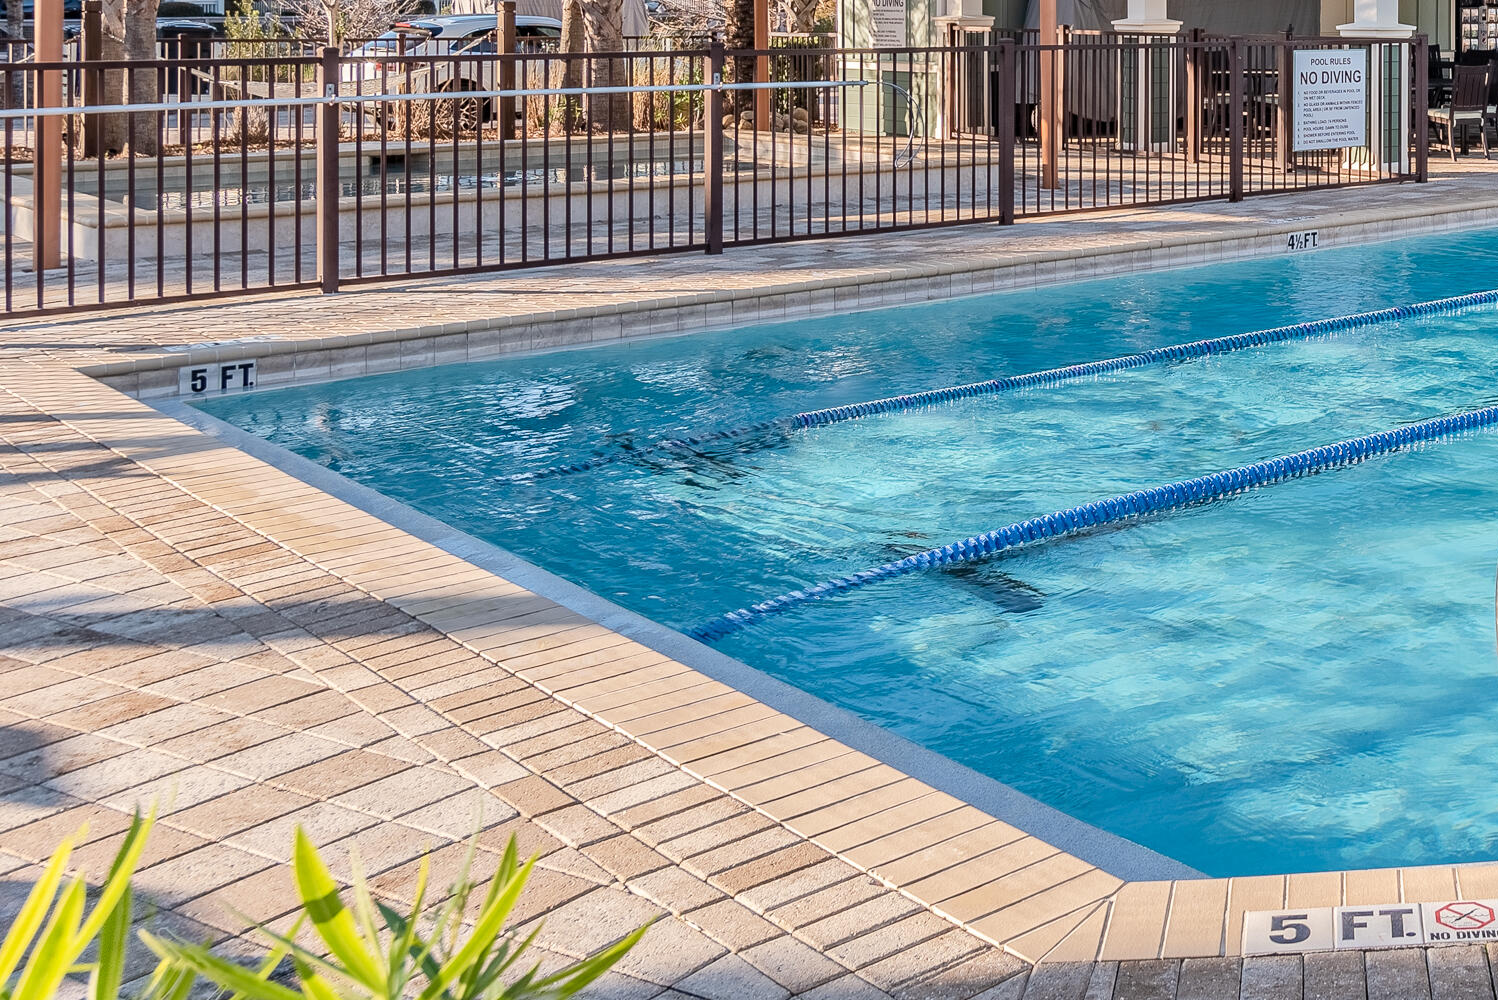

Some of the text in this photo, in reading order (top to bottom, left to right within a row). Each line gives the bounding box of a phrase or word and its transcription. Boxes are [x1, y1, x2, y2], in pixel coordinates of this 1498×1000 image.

[1311, 57, 1351, 66] POOL RULES
[1300, 70, 1362, 85] NO DIVING
[191, 363, 255, 393] 5 FT.
[1269, 908, 1417, 944] 5 FT.
[1429, 931, 1451, 941] NO
